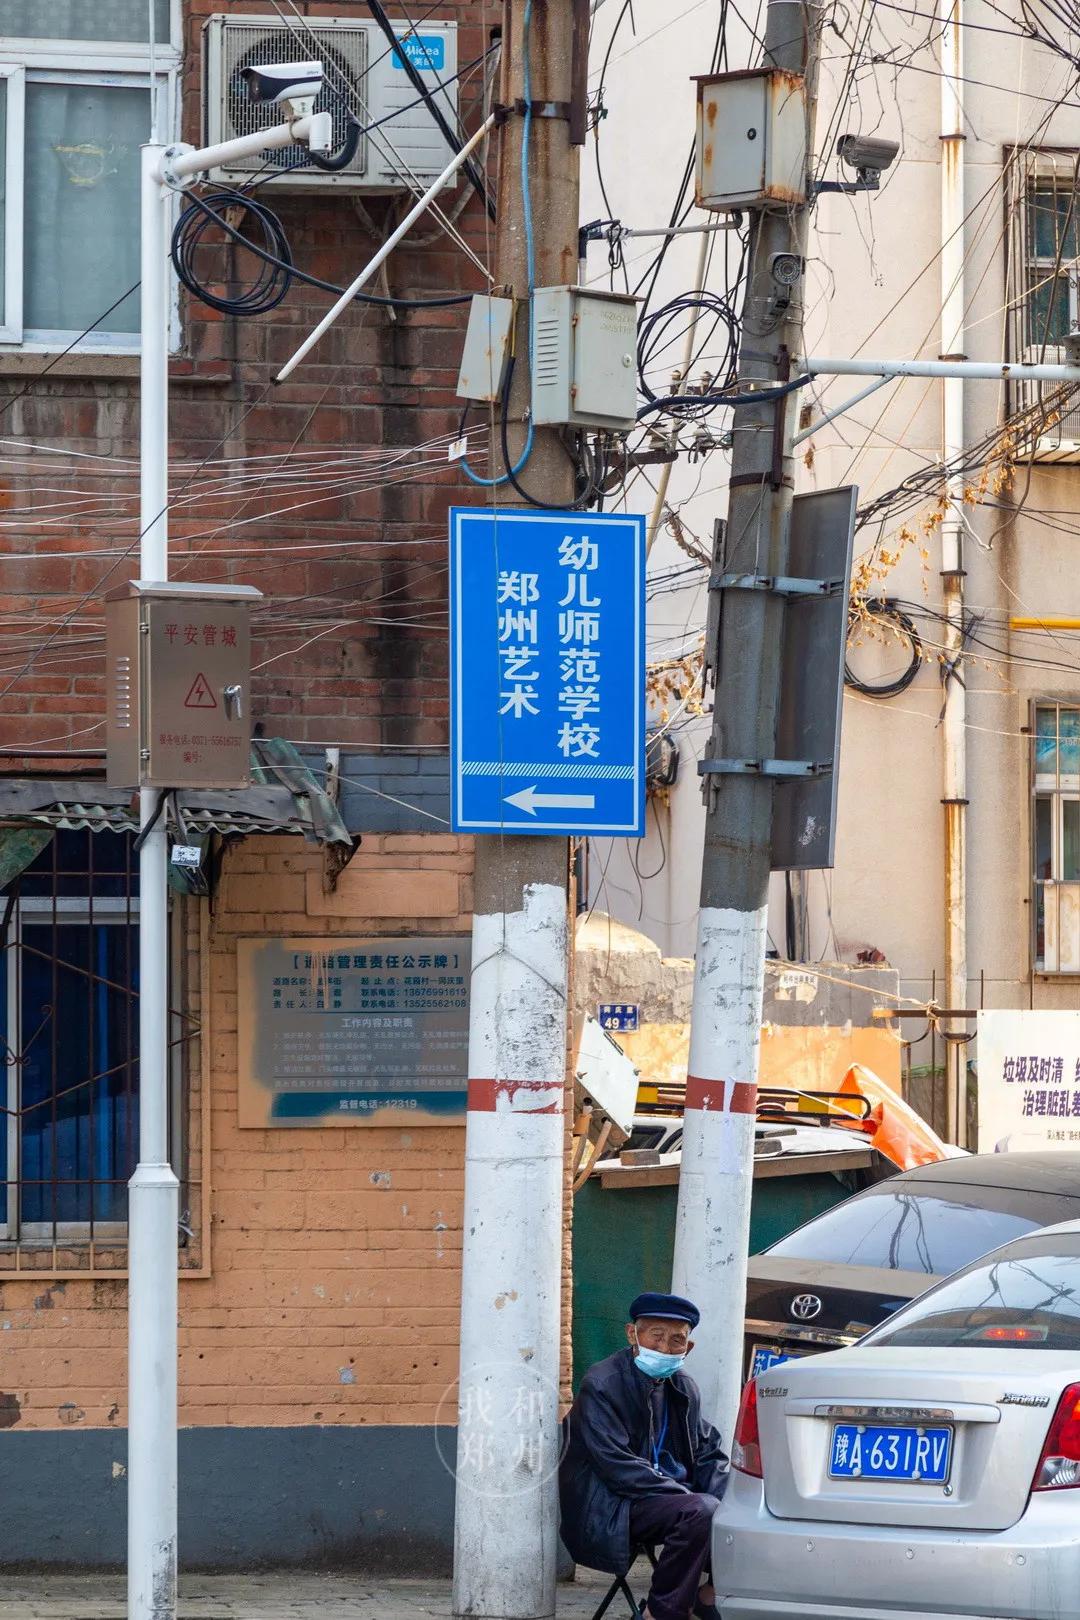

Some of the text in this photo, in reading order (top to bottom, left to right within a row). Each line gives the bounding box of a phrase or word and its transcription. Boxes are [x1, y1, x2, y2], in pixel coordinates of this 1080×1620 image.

[406, 44, 440, 56] Midea
[414, 57, 435, 67] 美的
[163, 623, 237, 647] 平安管城
[497, 571, 541, 719] 郑州艺术
[557, 535, 601, 758] 幼儿师范学校
[604, 1017, 620, 1030] 49
[1003, 1056, 1064, 1083] 垃圾及时清
[1022, 1090, 1080, 1117] 治理脏乱差
[834, 1433, 947, 1474] 豫A·631RV
